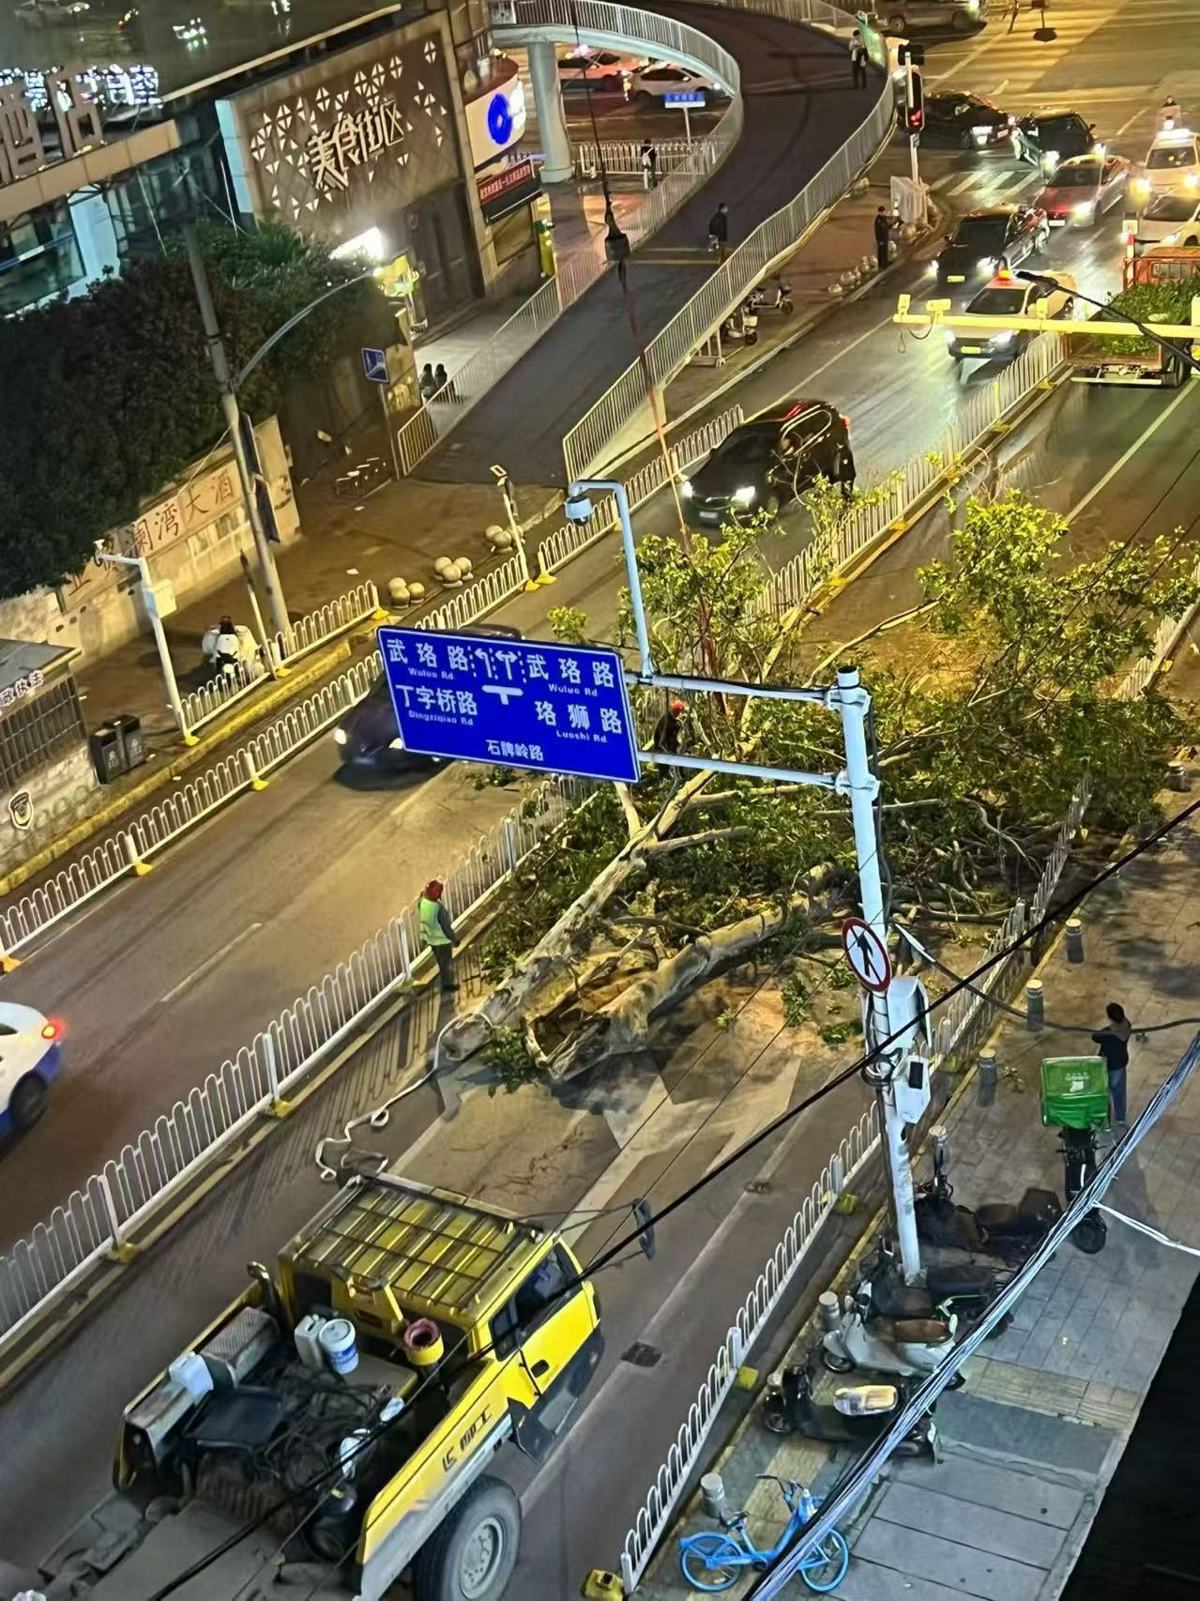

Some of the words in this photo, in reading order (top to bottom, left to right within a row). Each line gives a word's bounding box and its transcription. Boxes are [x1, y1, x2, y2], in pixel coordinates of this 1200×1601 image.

[387, 638, 469, 671] 武珞路
[441, 671, 454, 680] Rd
[526, 653, 614, 688] 武珞路
[395, 684, 478, 716] 丁字桥路
[548, 683, 580, 694] Wuluo
[584, 687, 598, 697] Rd
[461, 717, 474, 726] Rd
[534, 700, 622, 734] 珞狮路
[593, 733, 607, 743] Rd
[486, 739, 544, 761] 石牌岭路
